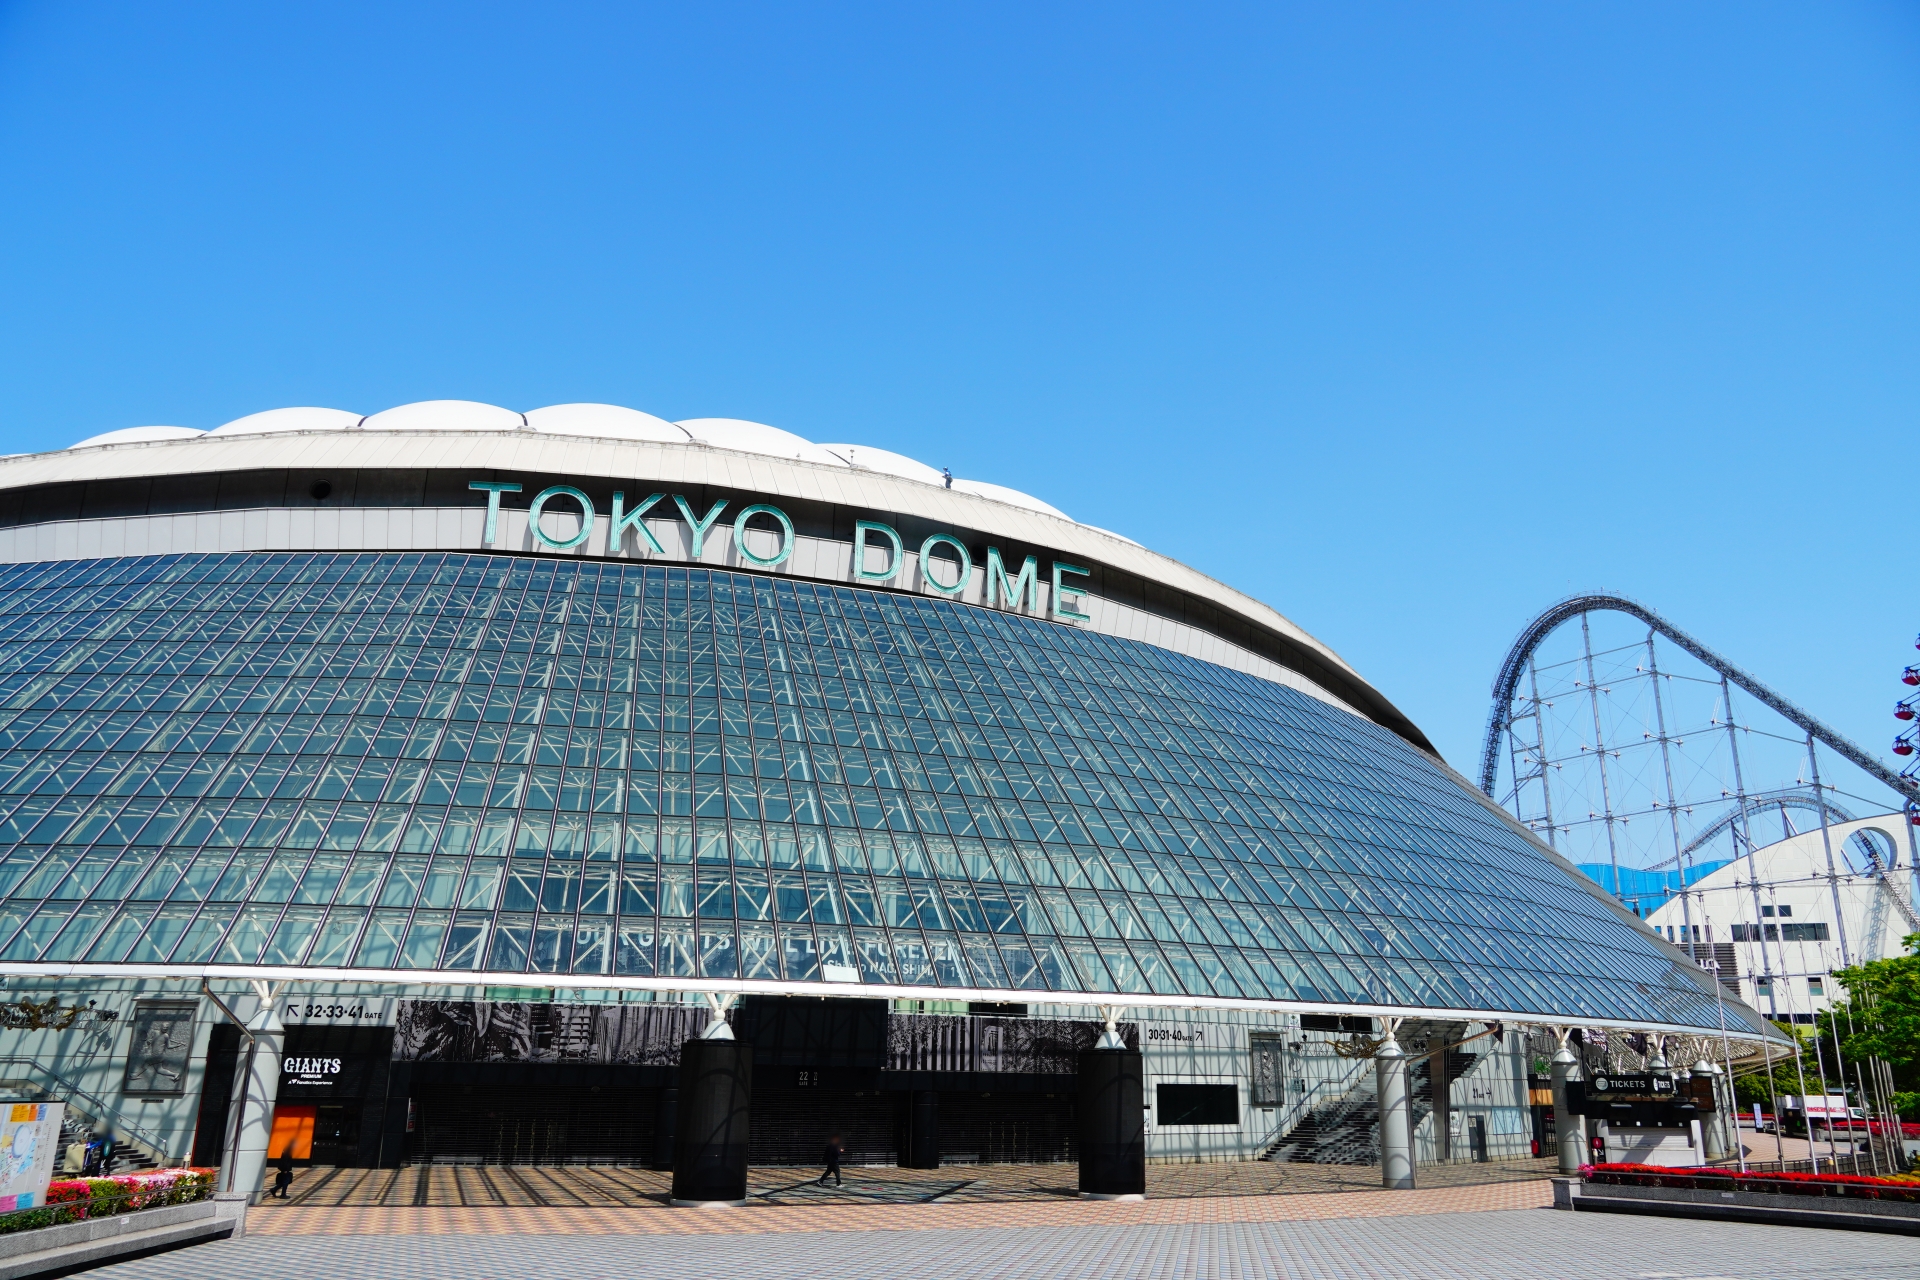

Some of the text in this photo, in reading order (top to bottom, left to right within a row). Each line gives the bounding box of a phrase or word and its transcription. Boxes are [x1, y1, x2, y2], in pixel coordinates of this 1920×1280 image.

[468, 480, 1091, 623] TOKYO DOME
[284, 1057, 341, 1073] GIANTS
[1610, 1080, 1646, 1089] TICKETS
